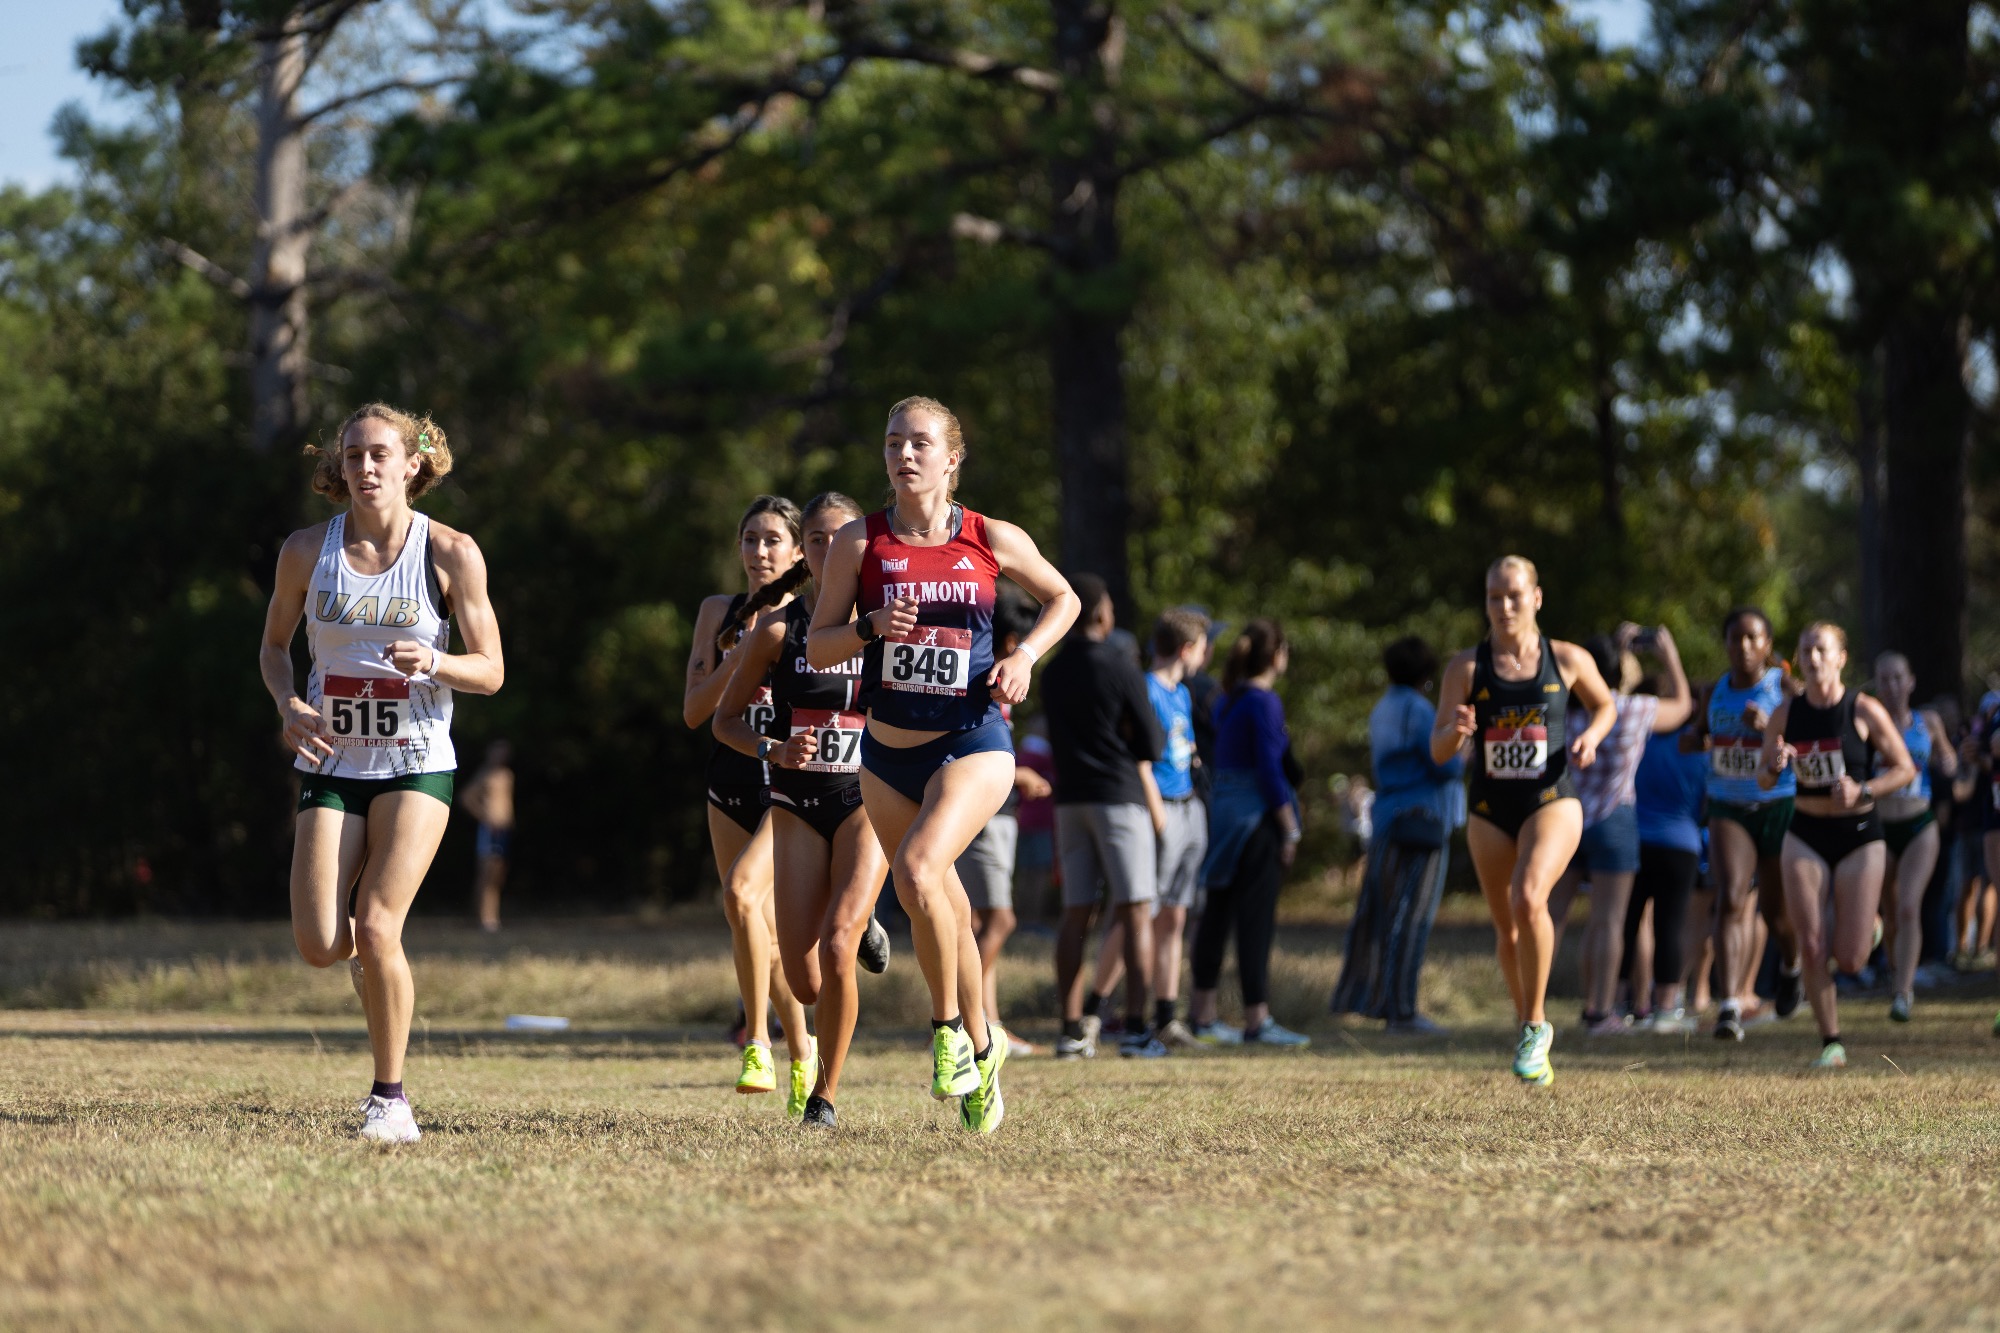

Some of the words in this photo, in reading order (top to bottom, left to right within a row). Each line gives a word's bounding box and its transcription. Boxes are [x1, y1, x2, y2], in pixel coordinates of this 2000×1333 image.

[881, 557, 909, 571] VALLEY
[882, 581, 979, 608] BELMONT
[315, 590, 420, 628] UAB
[892, 645, 959, 686] 349
[891, 682, 925, 694] CRIMSON
[926, 686, 957, 696] CLASSIC
[332, 698, 399, 737] 515
[333, 737, 366, 747] CRIMSON
[367, 739, 399, 747] CLASSIC
[803, 764, 831, 773] RIMSON
[831, 765, 860, 774] CLASSIC
[1492, 743, 1538, 769] 382
